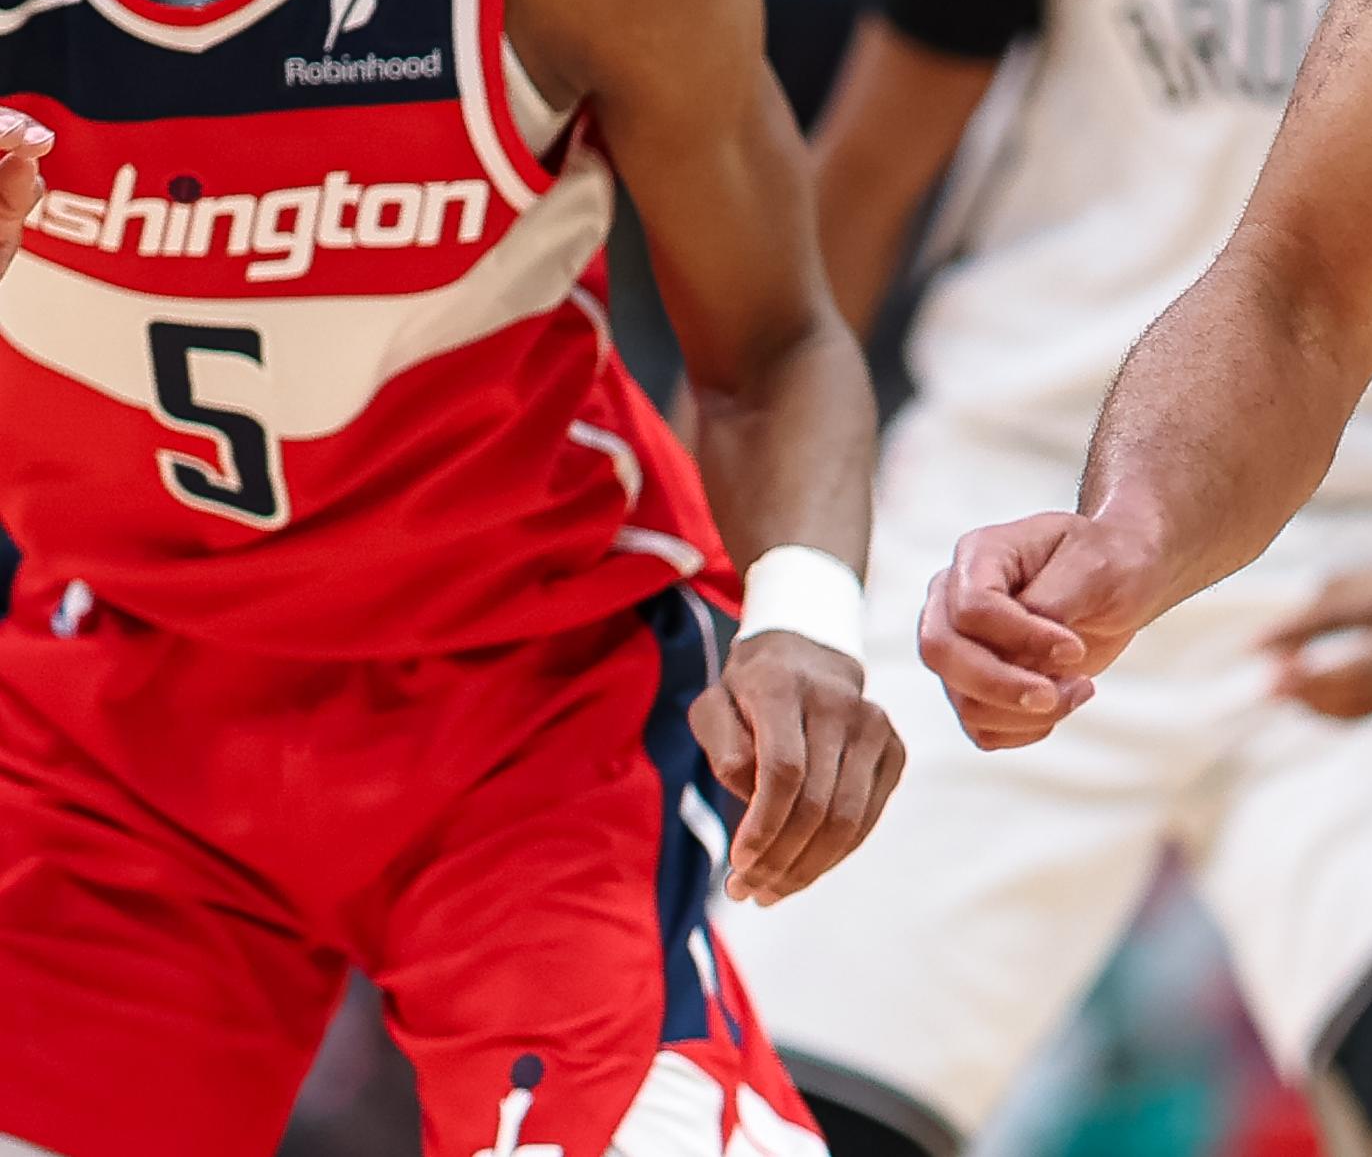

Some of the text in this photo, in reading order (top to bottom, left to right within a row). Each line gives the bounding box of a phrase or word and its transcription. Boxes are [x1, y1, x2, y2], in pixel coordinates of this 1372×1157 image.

[284, 47, 443, 87] Robinhood
[26, 162, 489, 283] shington
[147, 316, 288, 529] 5
